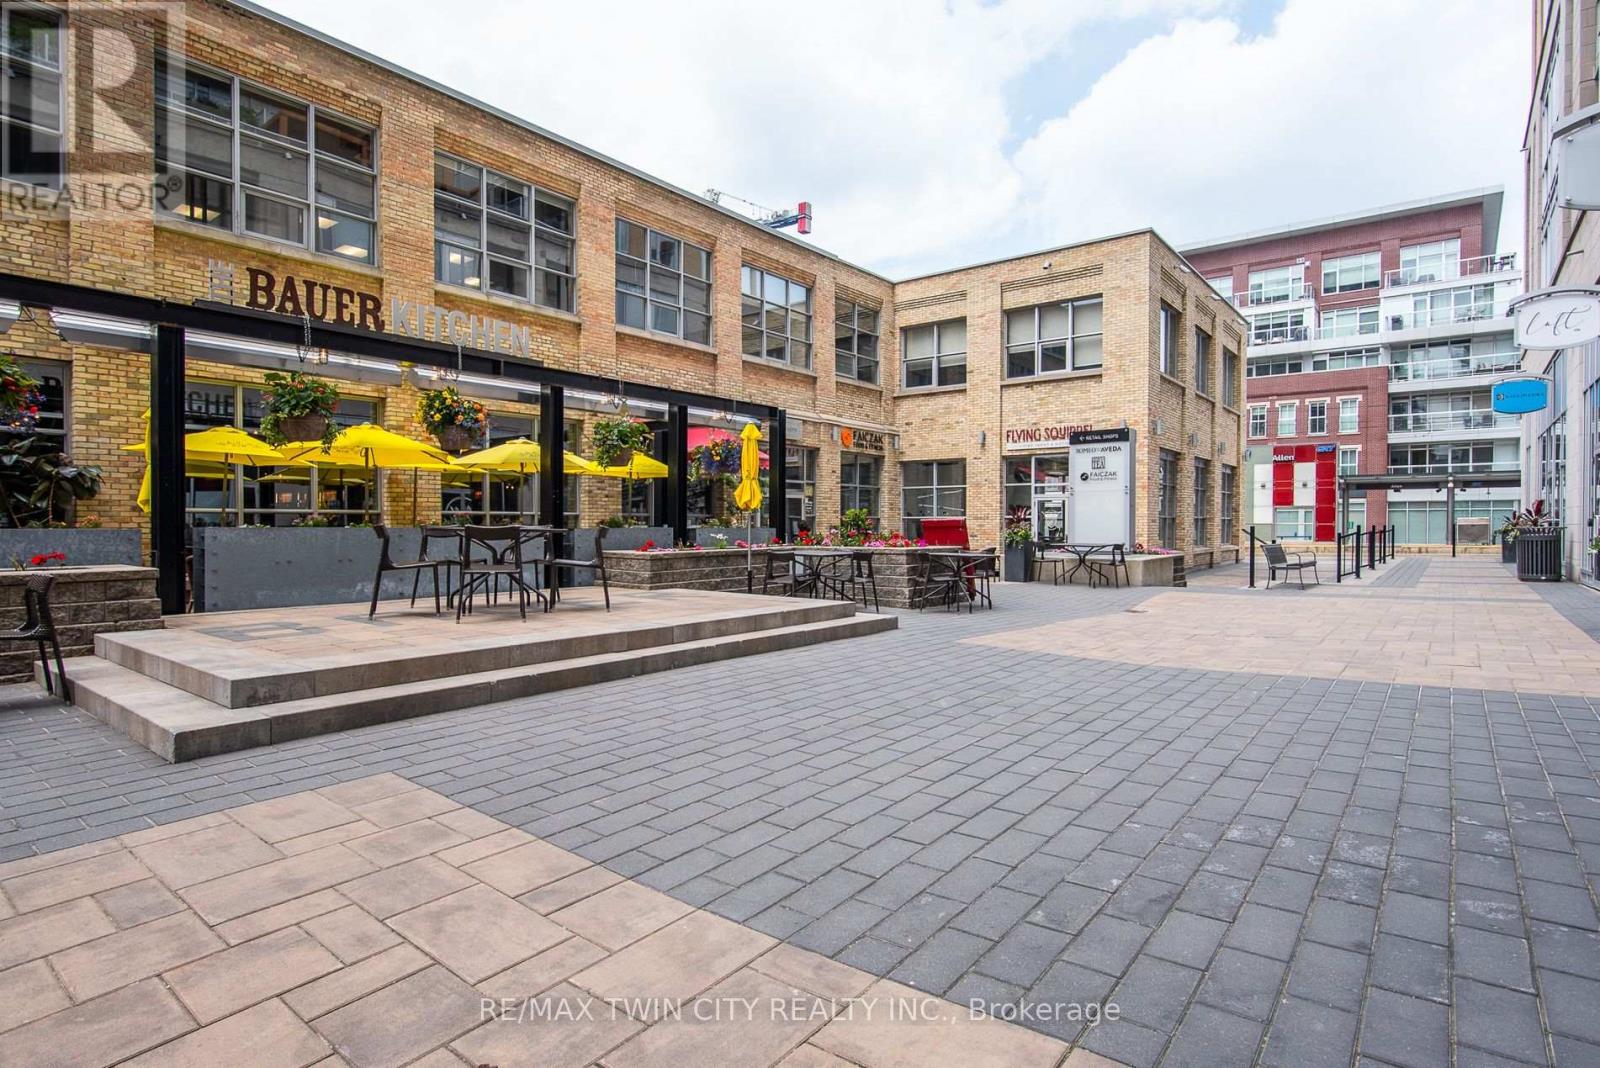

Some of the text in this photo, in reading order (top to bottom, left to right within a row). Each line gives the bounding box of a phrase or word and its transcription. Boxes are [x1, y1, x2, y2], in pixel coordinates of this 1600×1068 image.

[245, 266, 385, 332] BAUER
[391, 296, 530, 358] KITCHEN
[1006, 428, 1041, 443] FLYING
